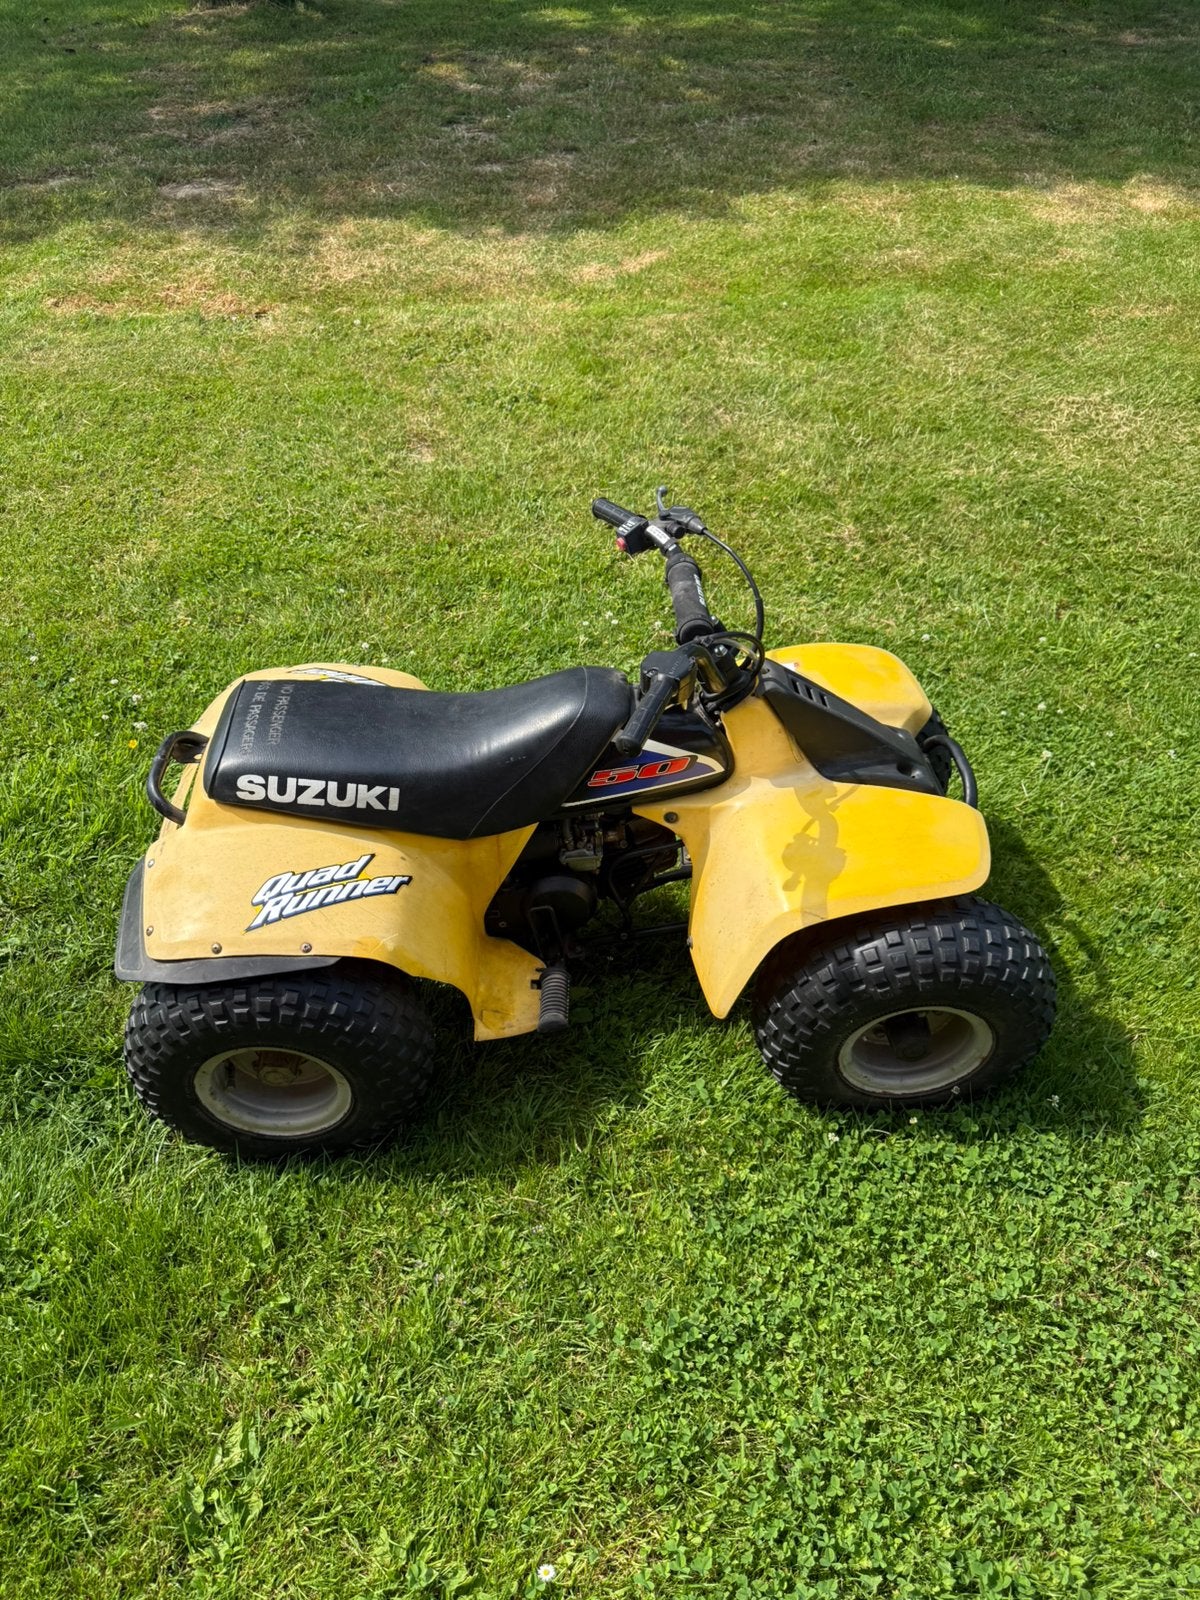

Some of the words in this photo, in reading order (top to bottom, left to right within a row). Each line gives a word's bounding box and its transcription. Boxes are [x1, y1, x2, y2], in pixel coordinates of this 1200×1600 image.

[252, 692, 267, 702] DE
[267, 696, 291, 745] PASSENGER
[235, 774, 400, 811] SUZUKI
[587, 755, 694, 787] 50
[251, 853, 375, 905] Quad
[244, 876, 413, 932] Runner
